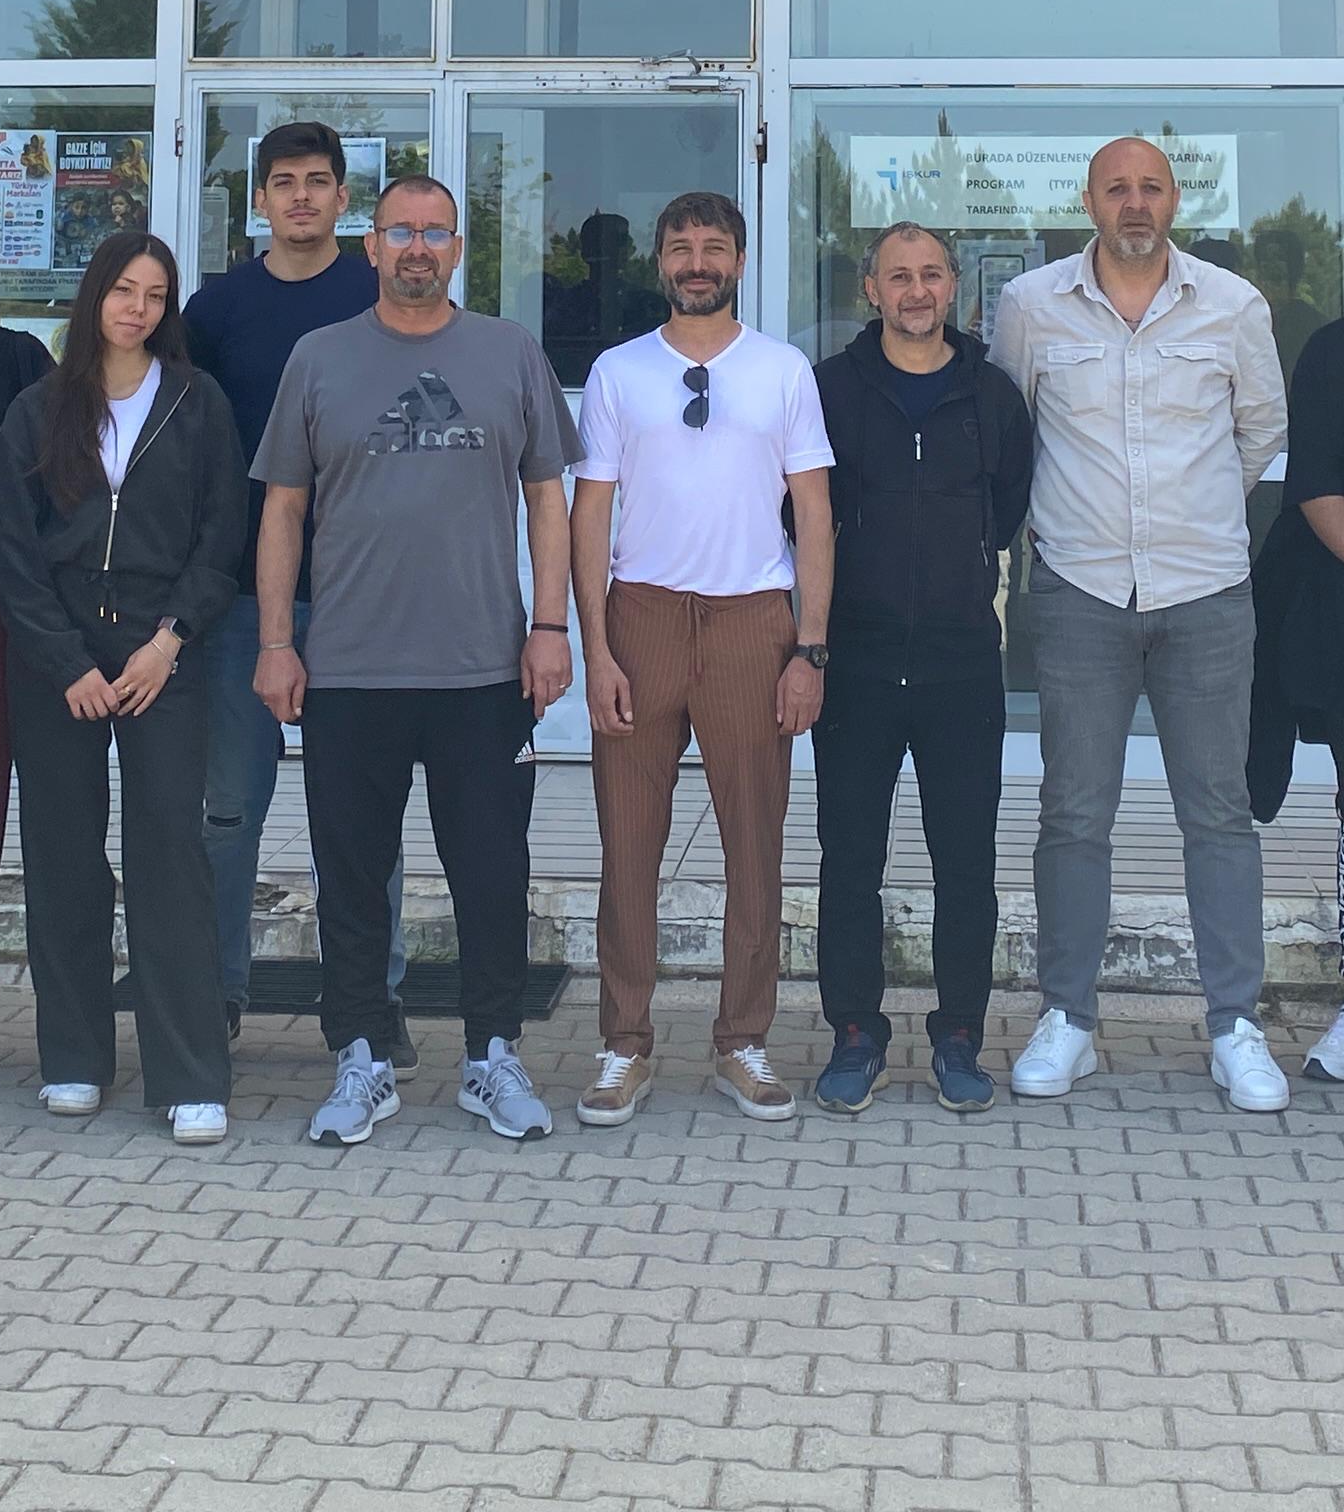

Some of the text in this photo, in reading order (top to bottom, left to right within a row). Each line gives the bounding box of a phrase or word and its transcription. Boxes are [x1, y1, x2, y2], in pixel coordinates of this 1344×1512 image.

[66, 142, 88, 155] GAZZE
[966, 151, 1212, 163] BURADA DÜZENLENEN RARINA
[966, 179, 1025, 189] PROGRAM
[1049, 179, 1078, 191] (TYP)
[966, 205, 1033, 215] TARAFINDAN
